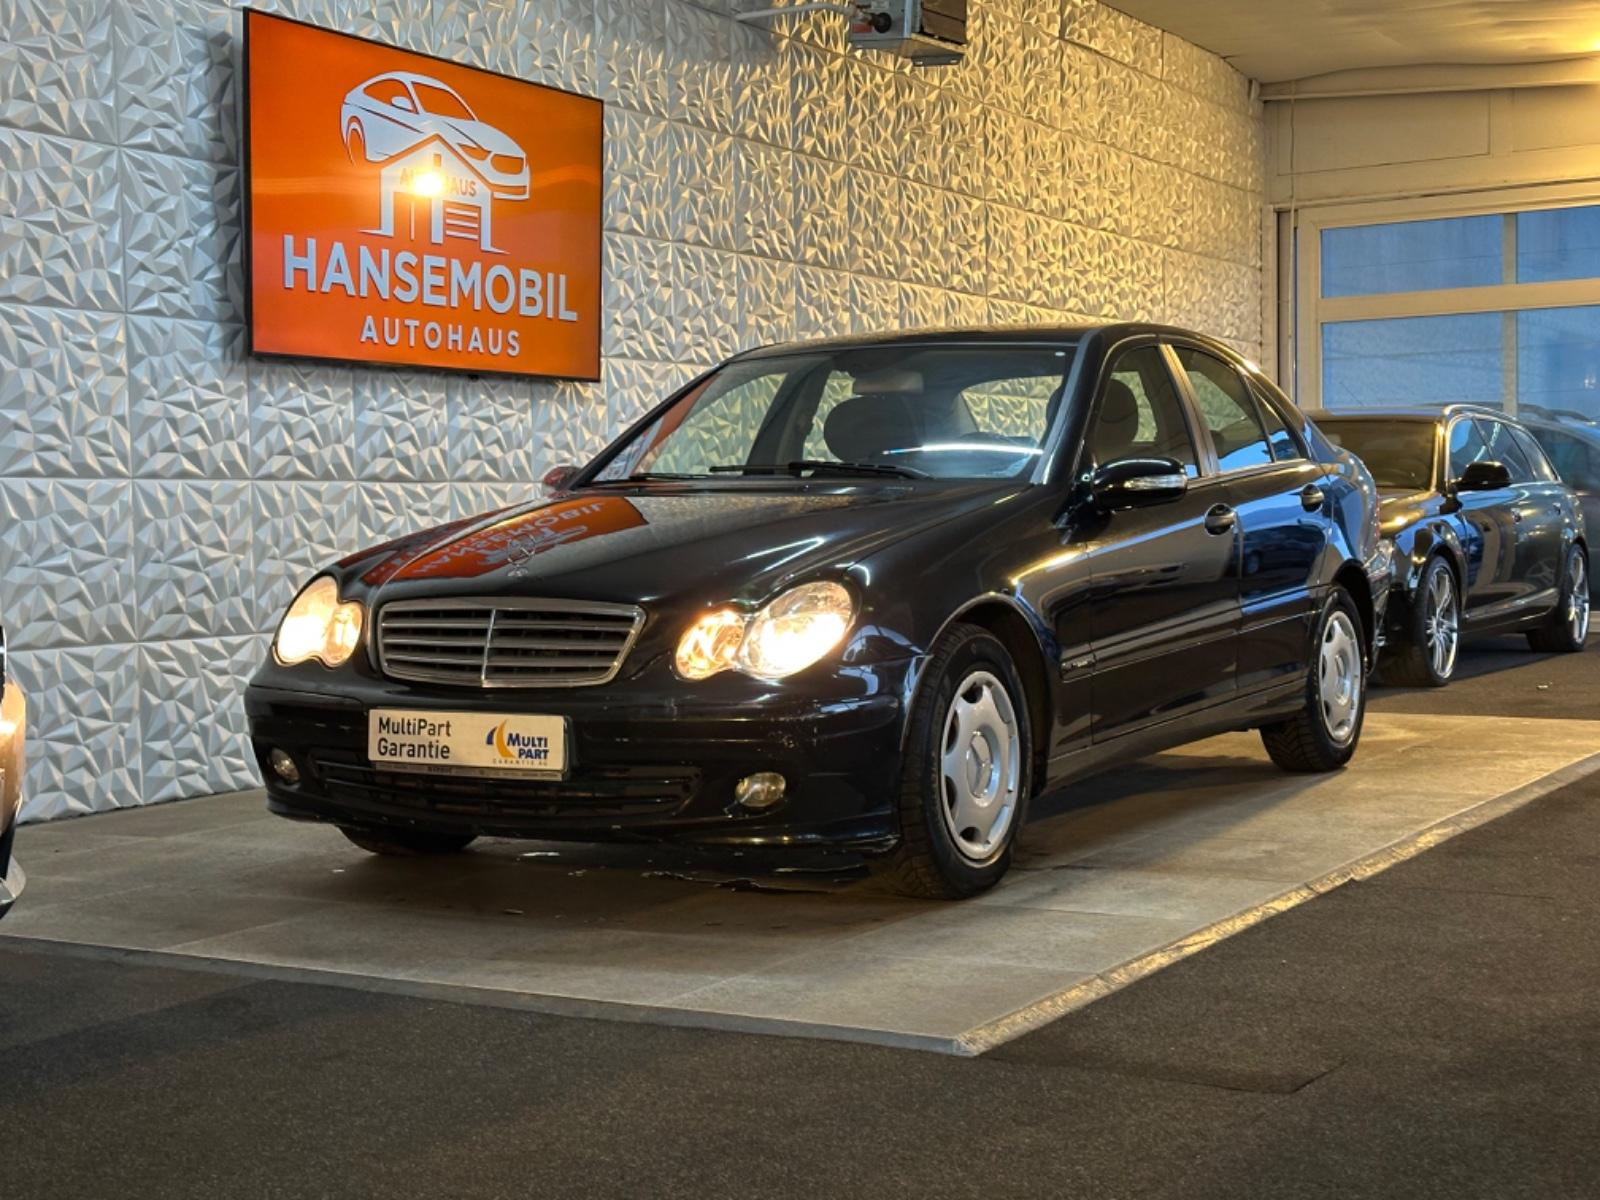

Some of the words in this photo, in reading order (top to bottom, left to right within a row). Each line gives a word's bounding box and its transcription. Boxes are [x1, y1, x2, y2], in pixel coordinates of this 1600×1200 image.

[400, 168, 477, 197] AAUS
[283, 234, 578, 322] HANSEMOBIL
[360, 315, 521, 357] AUTOHAUS
[378, 716, 452, 738] MultiPart
[377, 738, 451, 759] Garantie
[507, 732, 549, 748] MULTI
[518, 748, 549, 760] PART
